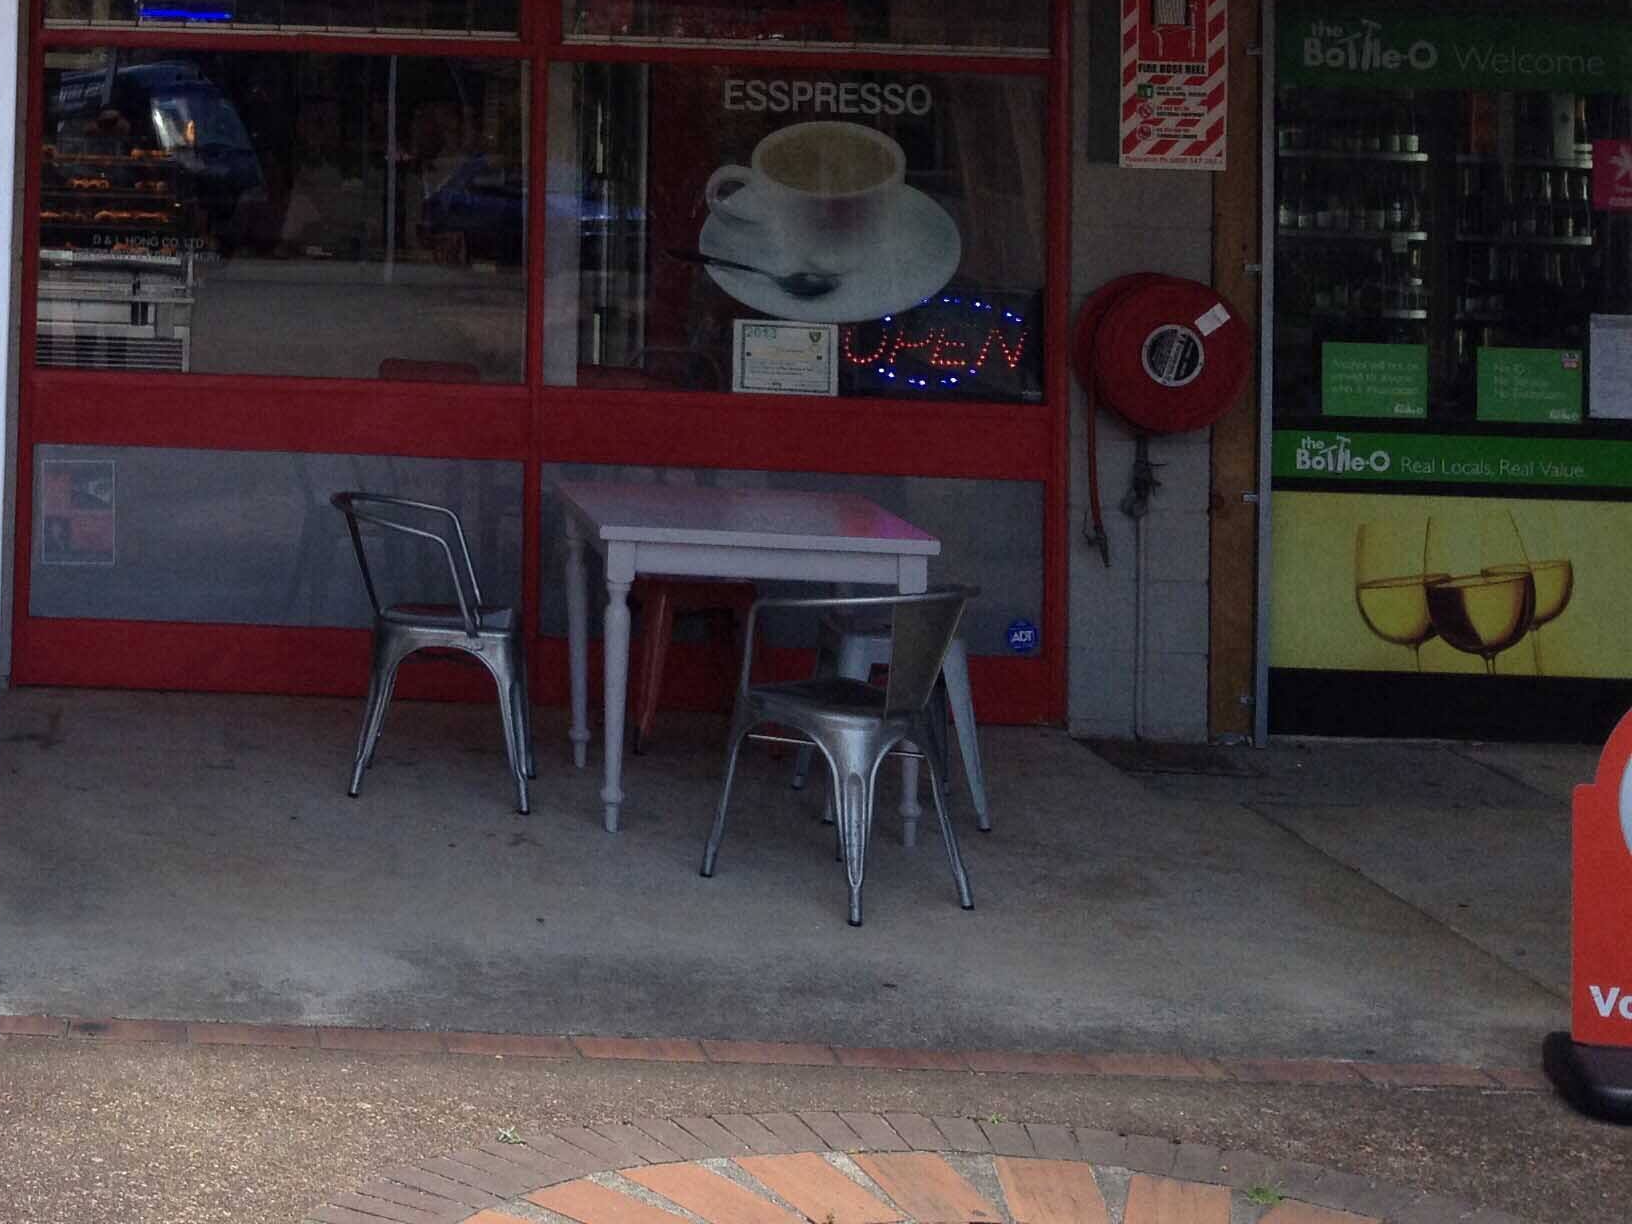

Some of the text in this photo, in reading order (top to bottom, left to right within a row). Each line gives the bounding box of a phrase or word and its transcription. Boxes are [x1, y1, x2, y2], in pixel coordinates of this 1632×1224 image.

[1452, 42, 1607, 76] Welcome
[723, 79, 933, 116] ESSPRESSO
[1300, 435, 1325, 450] the
[1400, 456, 1436, 473] Real
[1499, 458, 1535, 477] Real
[1010, 630, 1033, 643] ADT
